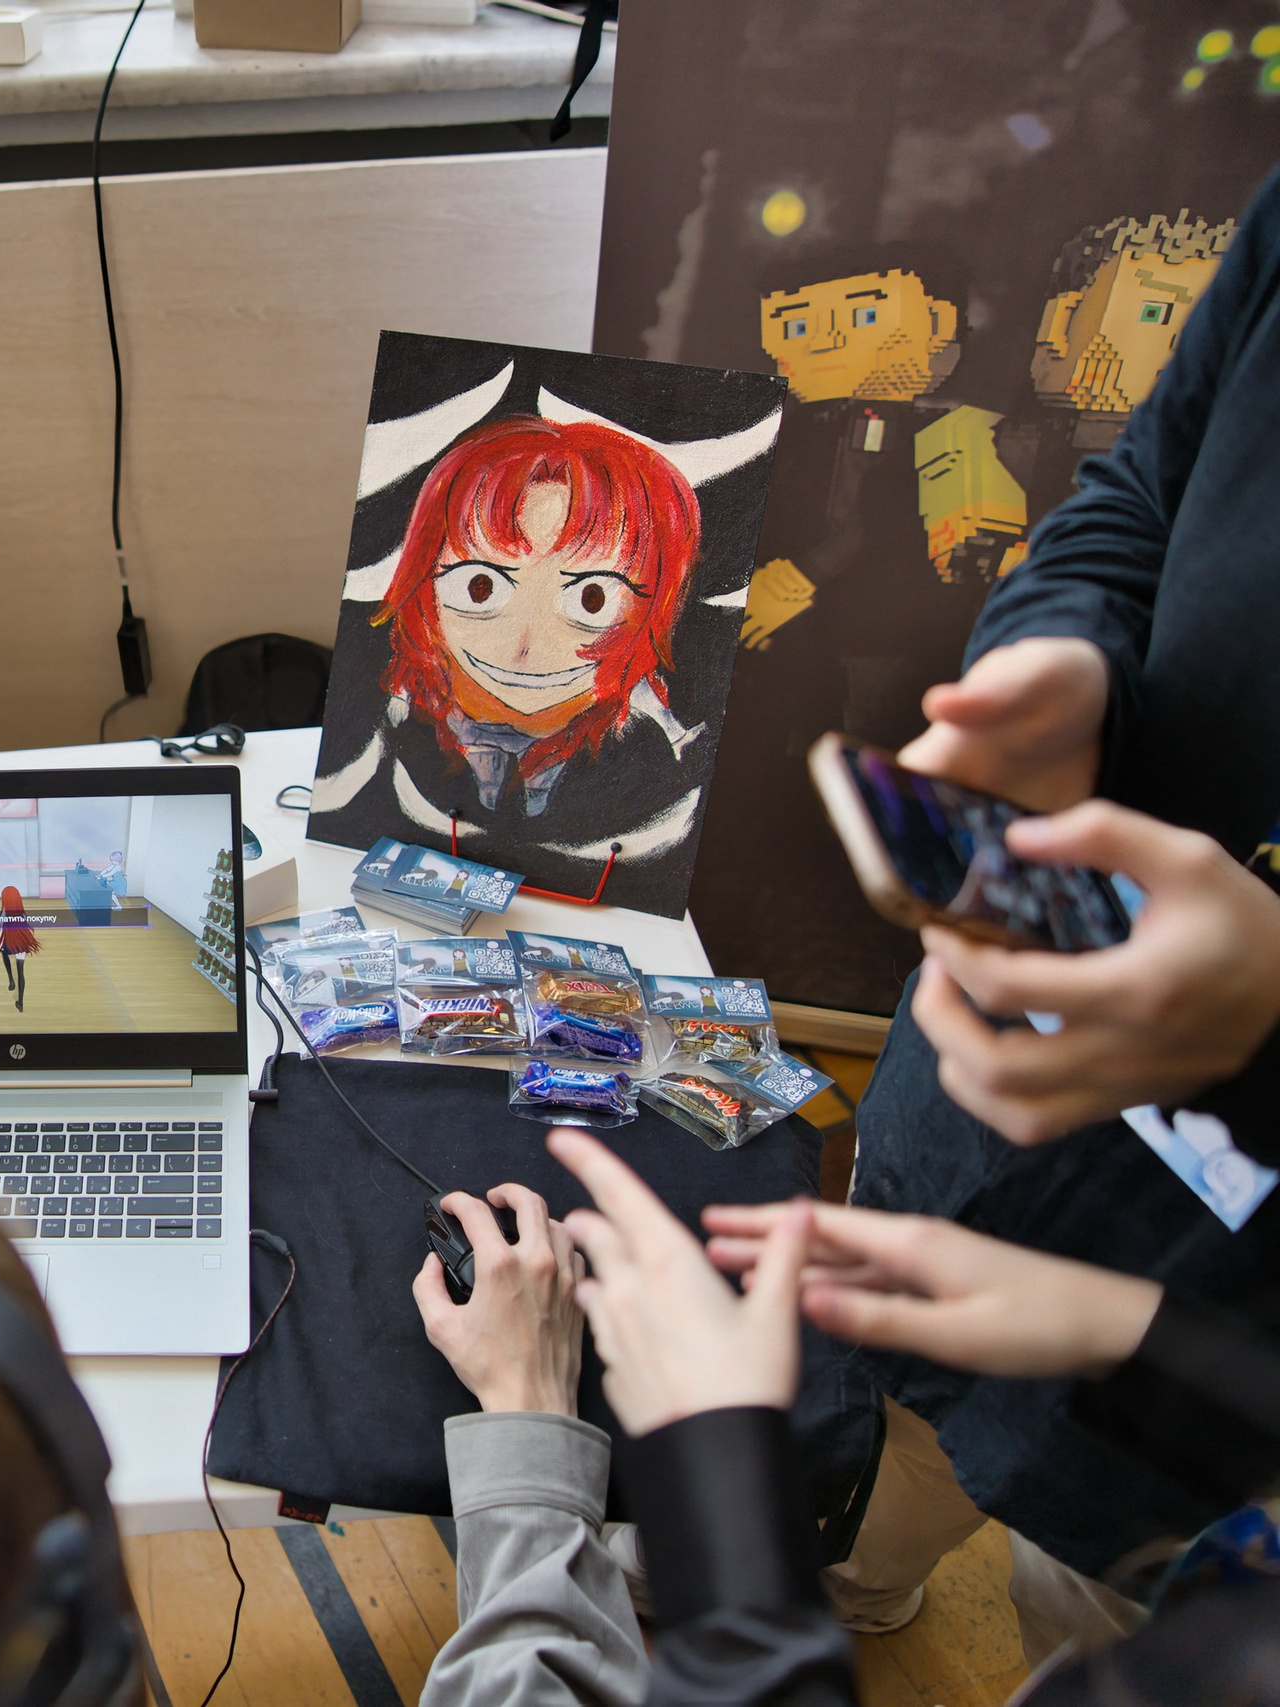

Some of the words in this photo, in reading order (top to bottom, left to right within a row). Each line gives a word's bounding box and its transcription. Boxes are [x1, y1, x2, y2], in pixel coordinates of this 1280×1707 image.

[398, 874, 419, 887] KILL
[421, 878, 445, 890] LOVE
[26, 915, 57, 924] покупку
[562, 981, 617, 995] TWIX
[10, 1043, 27, 1060] hp
